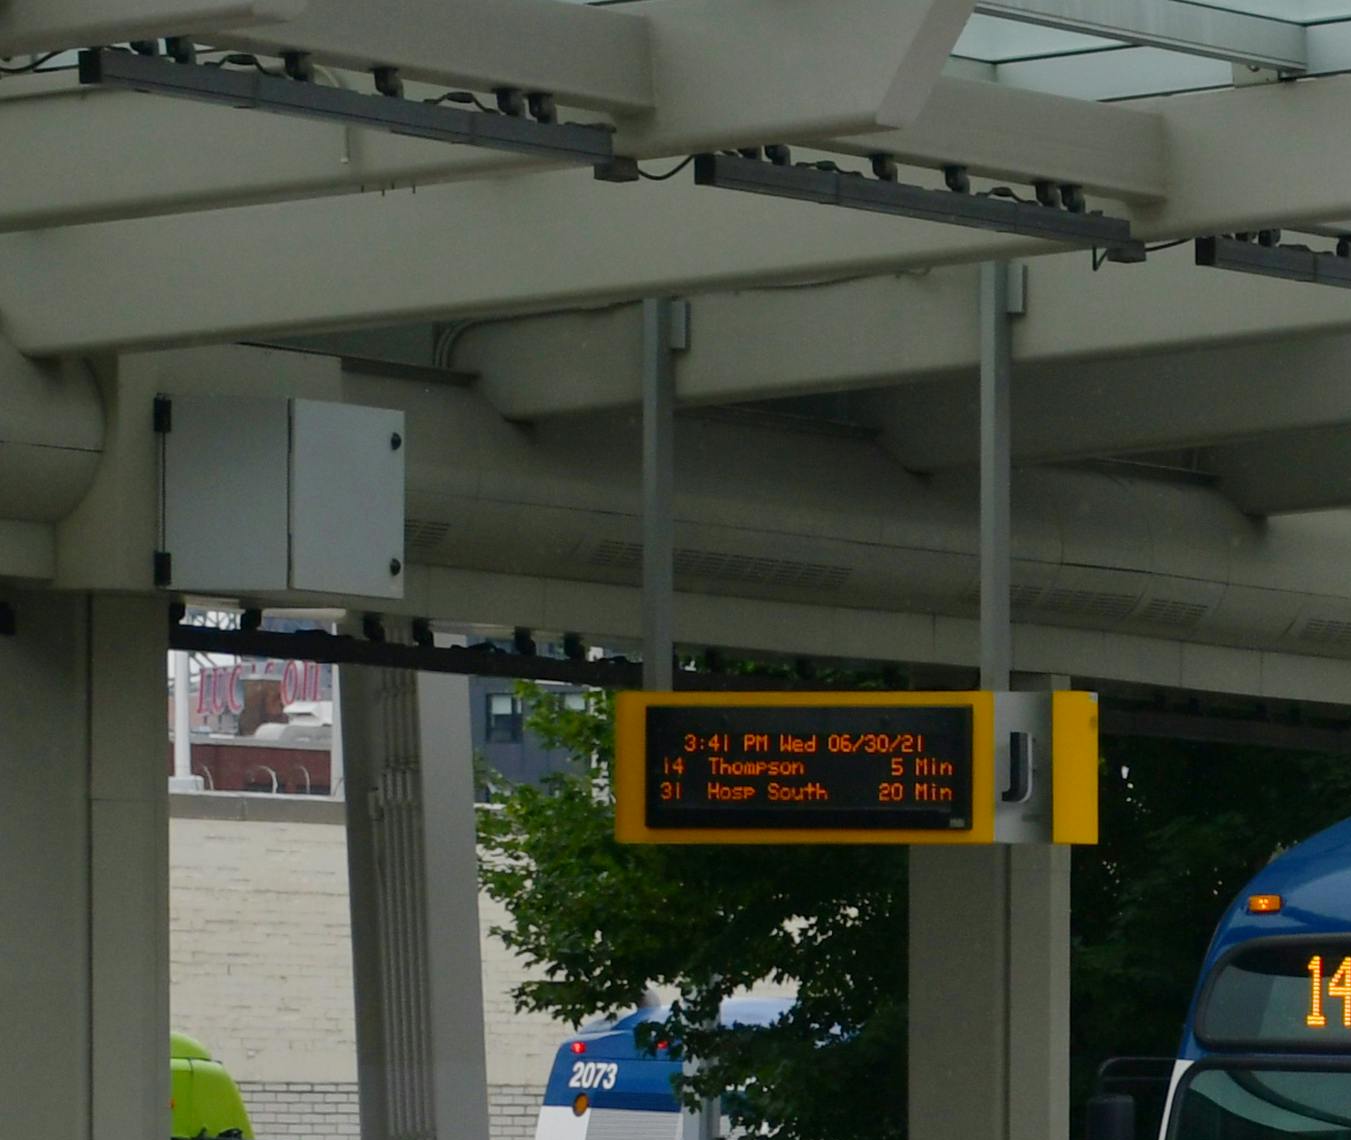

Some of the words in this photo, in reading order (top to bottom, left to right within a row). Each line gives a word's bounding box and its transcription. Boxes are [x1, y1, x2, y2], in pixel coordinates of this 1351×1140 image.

[684, 733, 728, 753] 3:41
[744, 734, 768, 752] PM
[780, 733, 816, 752] Wed
[828, 733, 924, 753] 06/30/21
[664, 756, 685, 775] 14
[708, 756, 805, 776] Thompson
[890, 757, 904, 776] 5
[915, 757, 953, 776] Min
[660, 781, 682, 800] 31
[707, 781, 756, 800] Hosp
[767, 781, 828, 801] South
[879, 783, 903, 801] 20
[915, 782, 953, 801] Min
[568, 1061, 618, 1090] 2073
